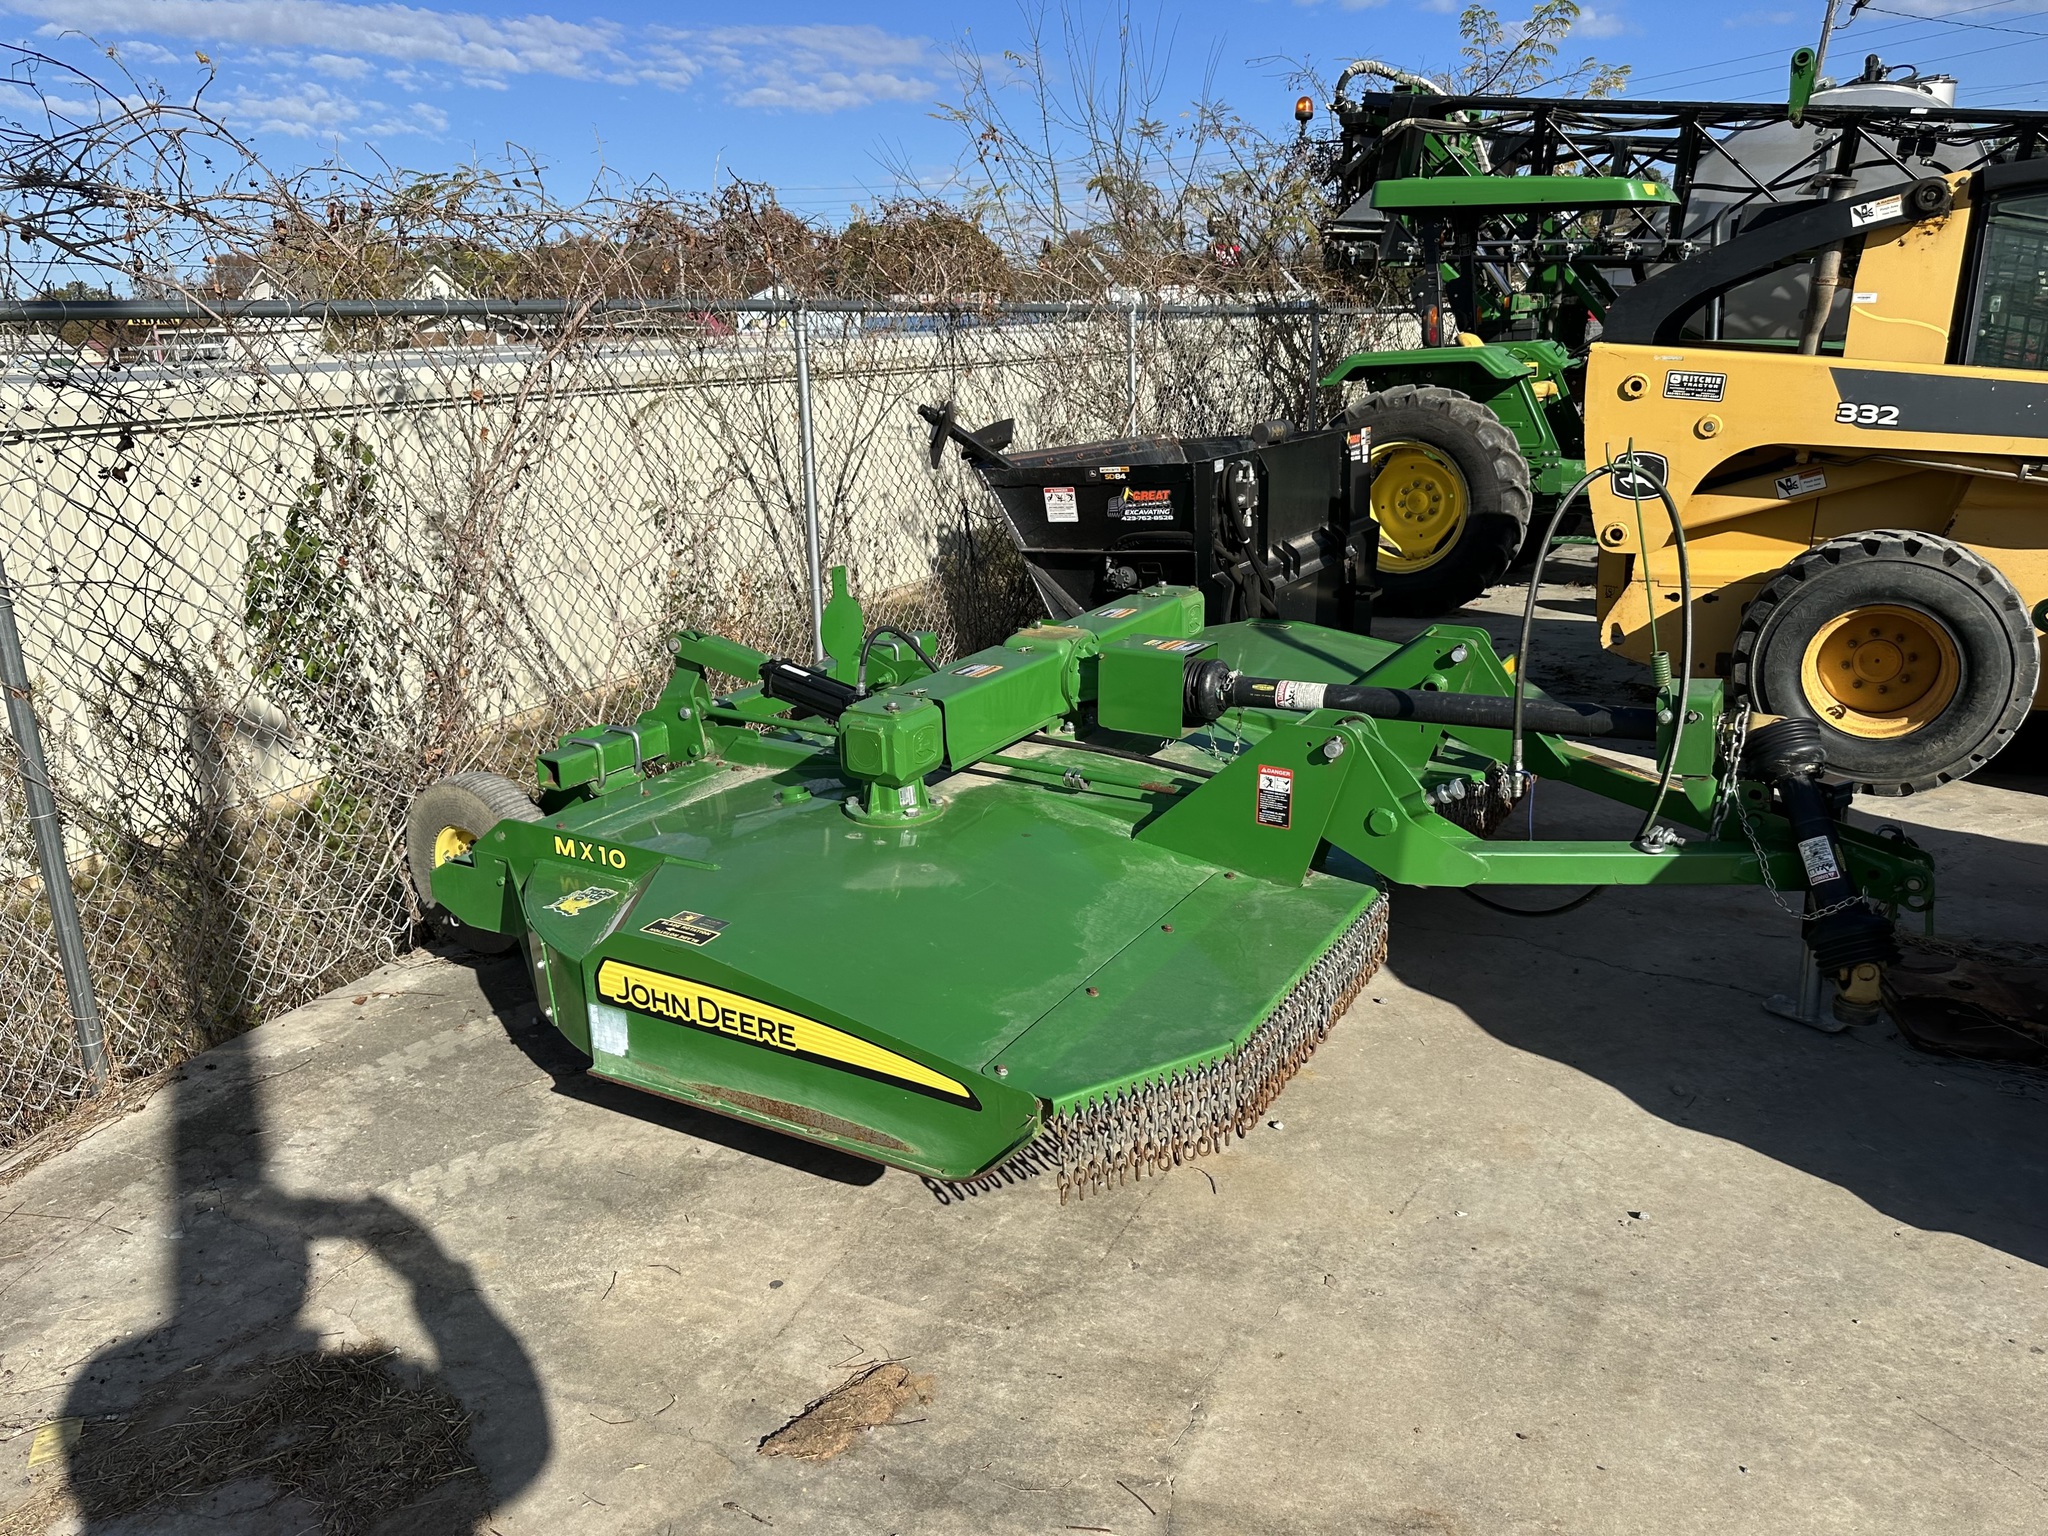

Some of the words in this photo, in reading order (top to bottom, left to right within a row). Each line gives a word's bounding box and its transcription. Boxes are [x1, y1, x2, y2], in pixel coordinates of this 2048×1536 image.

[1682, 375, 1722, 385] RITCHIE
[1835, 402, 1900, 426] 332
[1132, 490, 1171, 500] GREAT
[1266, 768, 1291, 777] DANGER
[554, 835, 627, 870] MX10
[681, 924, 712, 936] ROTATION
